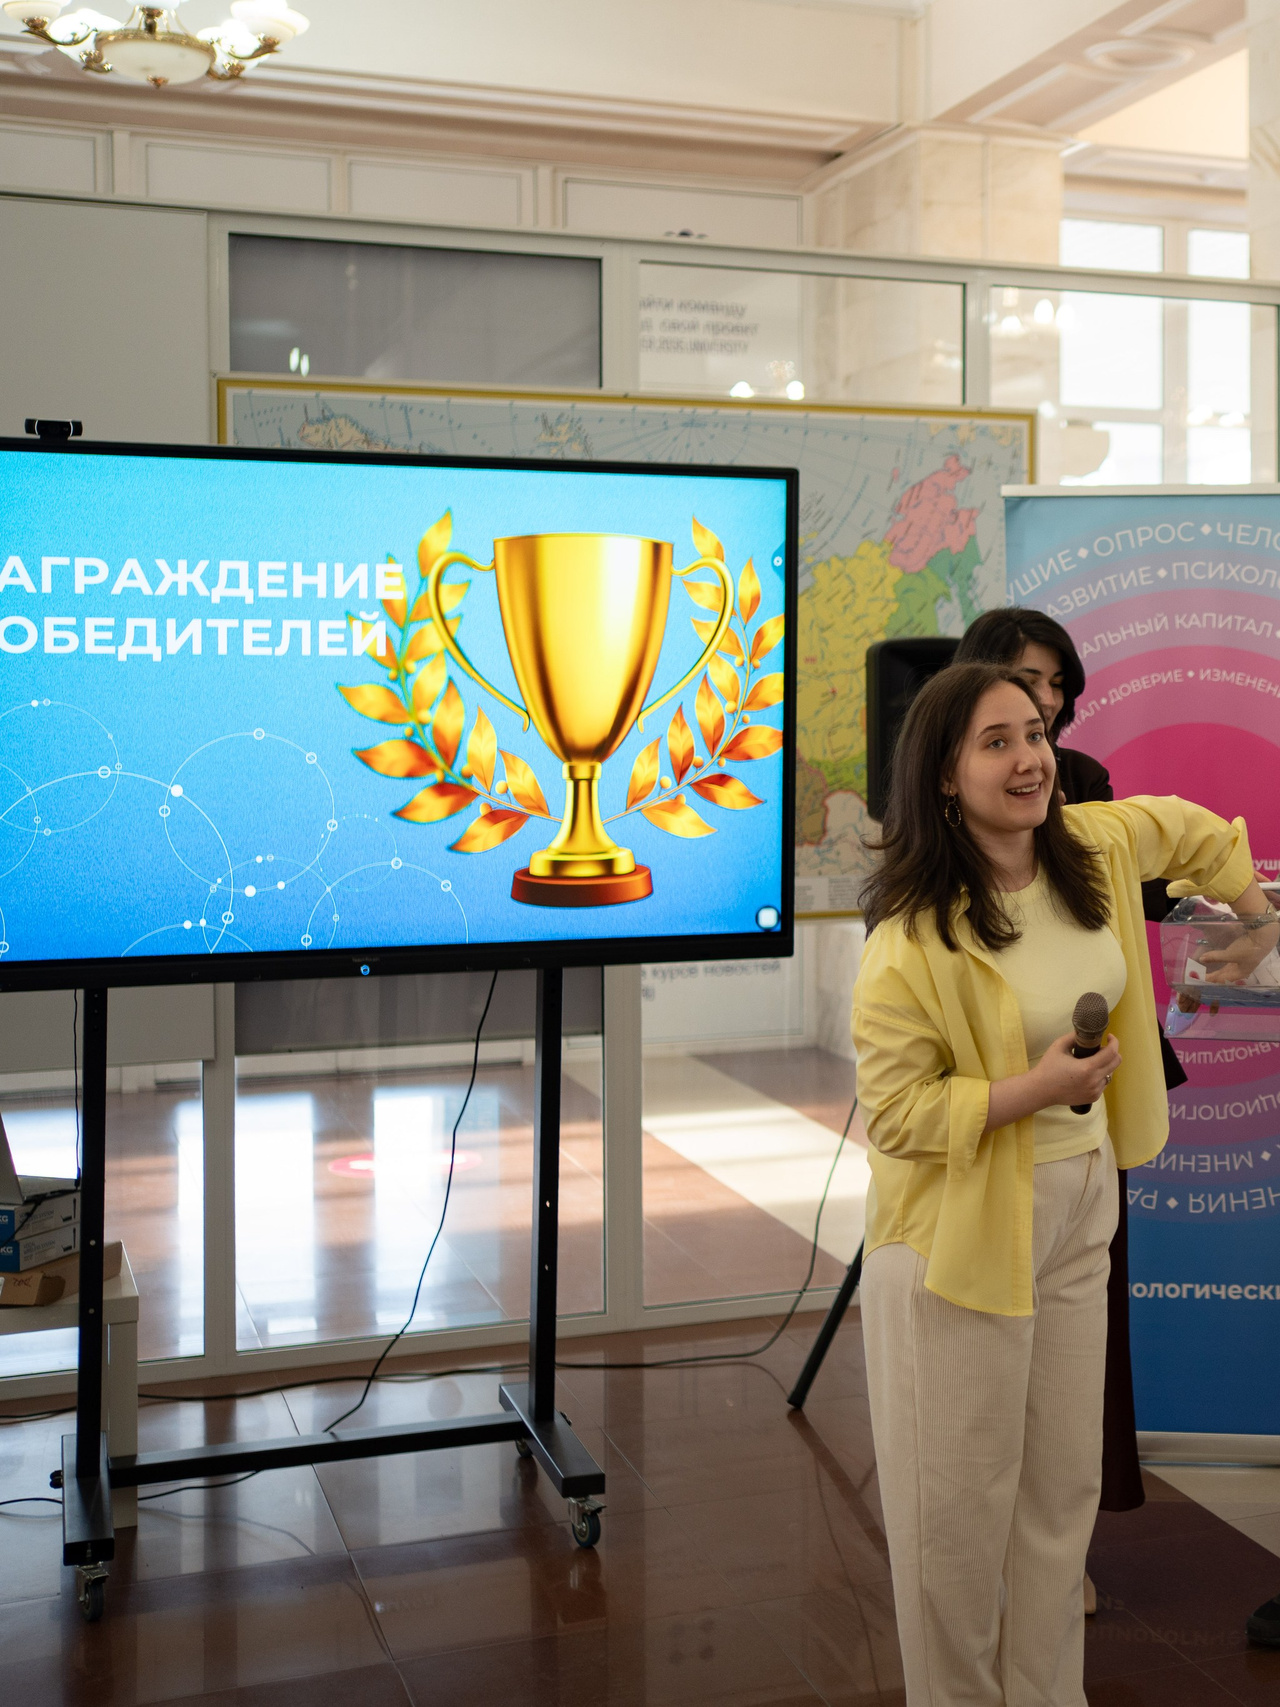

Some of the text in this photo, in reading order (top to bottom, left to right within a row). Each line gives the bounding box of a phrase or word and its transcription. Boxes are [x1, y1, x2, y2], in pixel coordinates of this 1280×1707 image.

[1093, 521, 1195, 557] ОПРОС
[0, 555, 404, 604] АГРАЖДЕНИЕ
[0, 610, 388, 661] ОБЕДИТЕЛЕЙ
[1080, 612, 1169, 659] АЛЬНЫЙ
[1175, 612, 1273, 638] КАПИТАЛ
[1108, 668, 1184, 705] ДОВЕРИЕ
